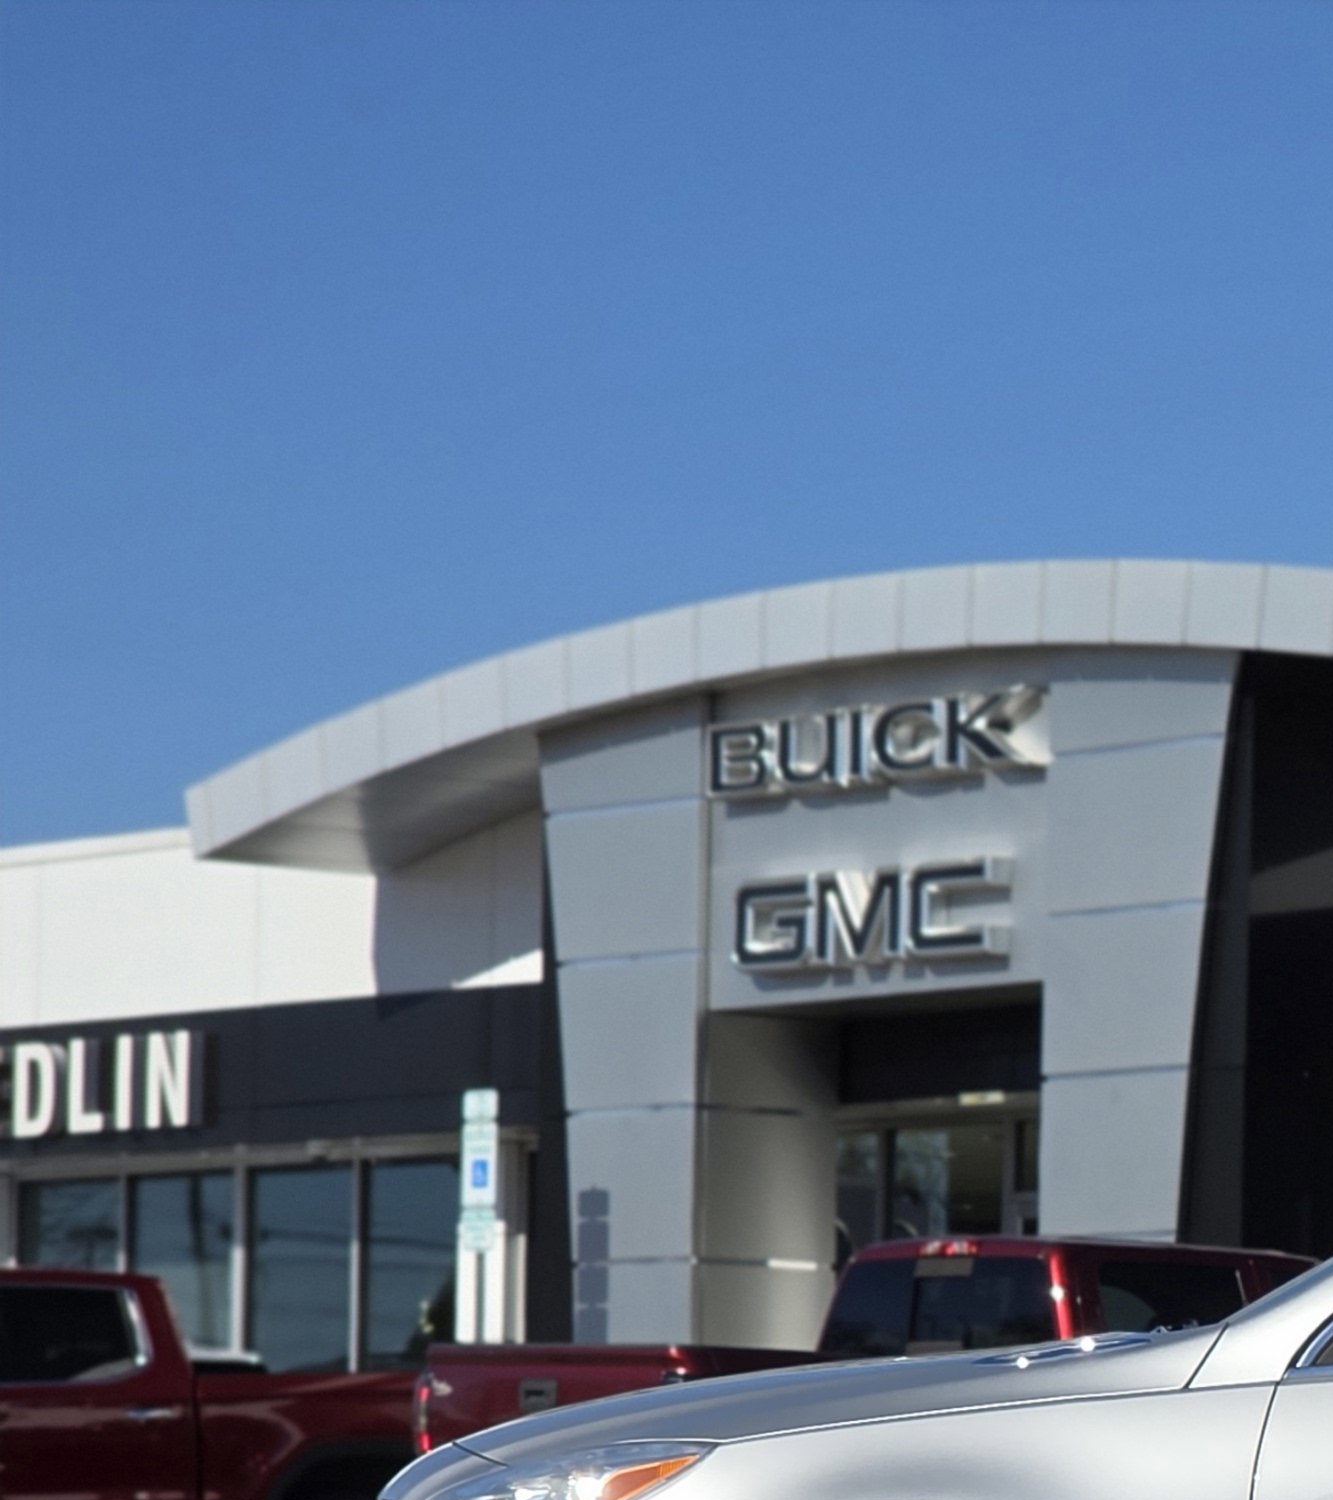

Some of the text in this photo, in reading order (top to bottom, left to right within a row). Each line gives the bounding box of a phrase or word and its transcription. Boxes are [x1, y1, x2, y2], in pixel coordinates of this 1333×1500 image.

[709, 690, 1016, 797] BUICK
[734, 860, 994, 967] GMC
[0, 1030, 192, 1140] DLIN
